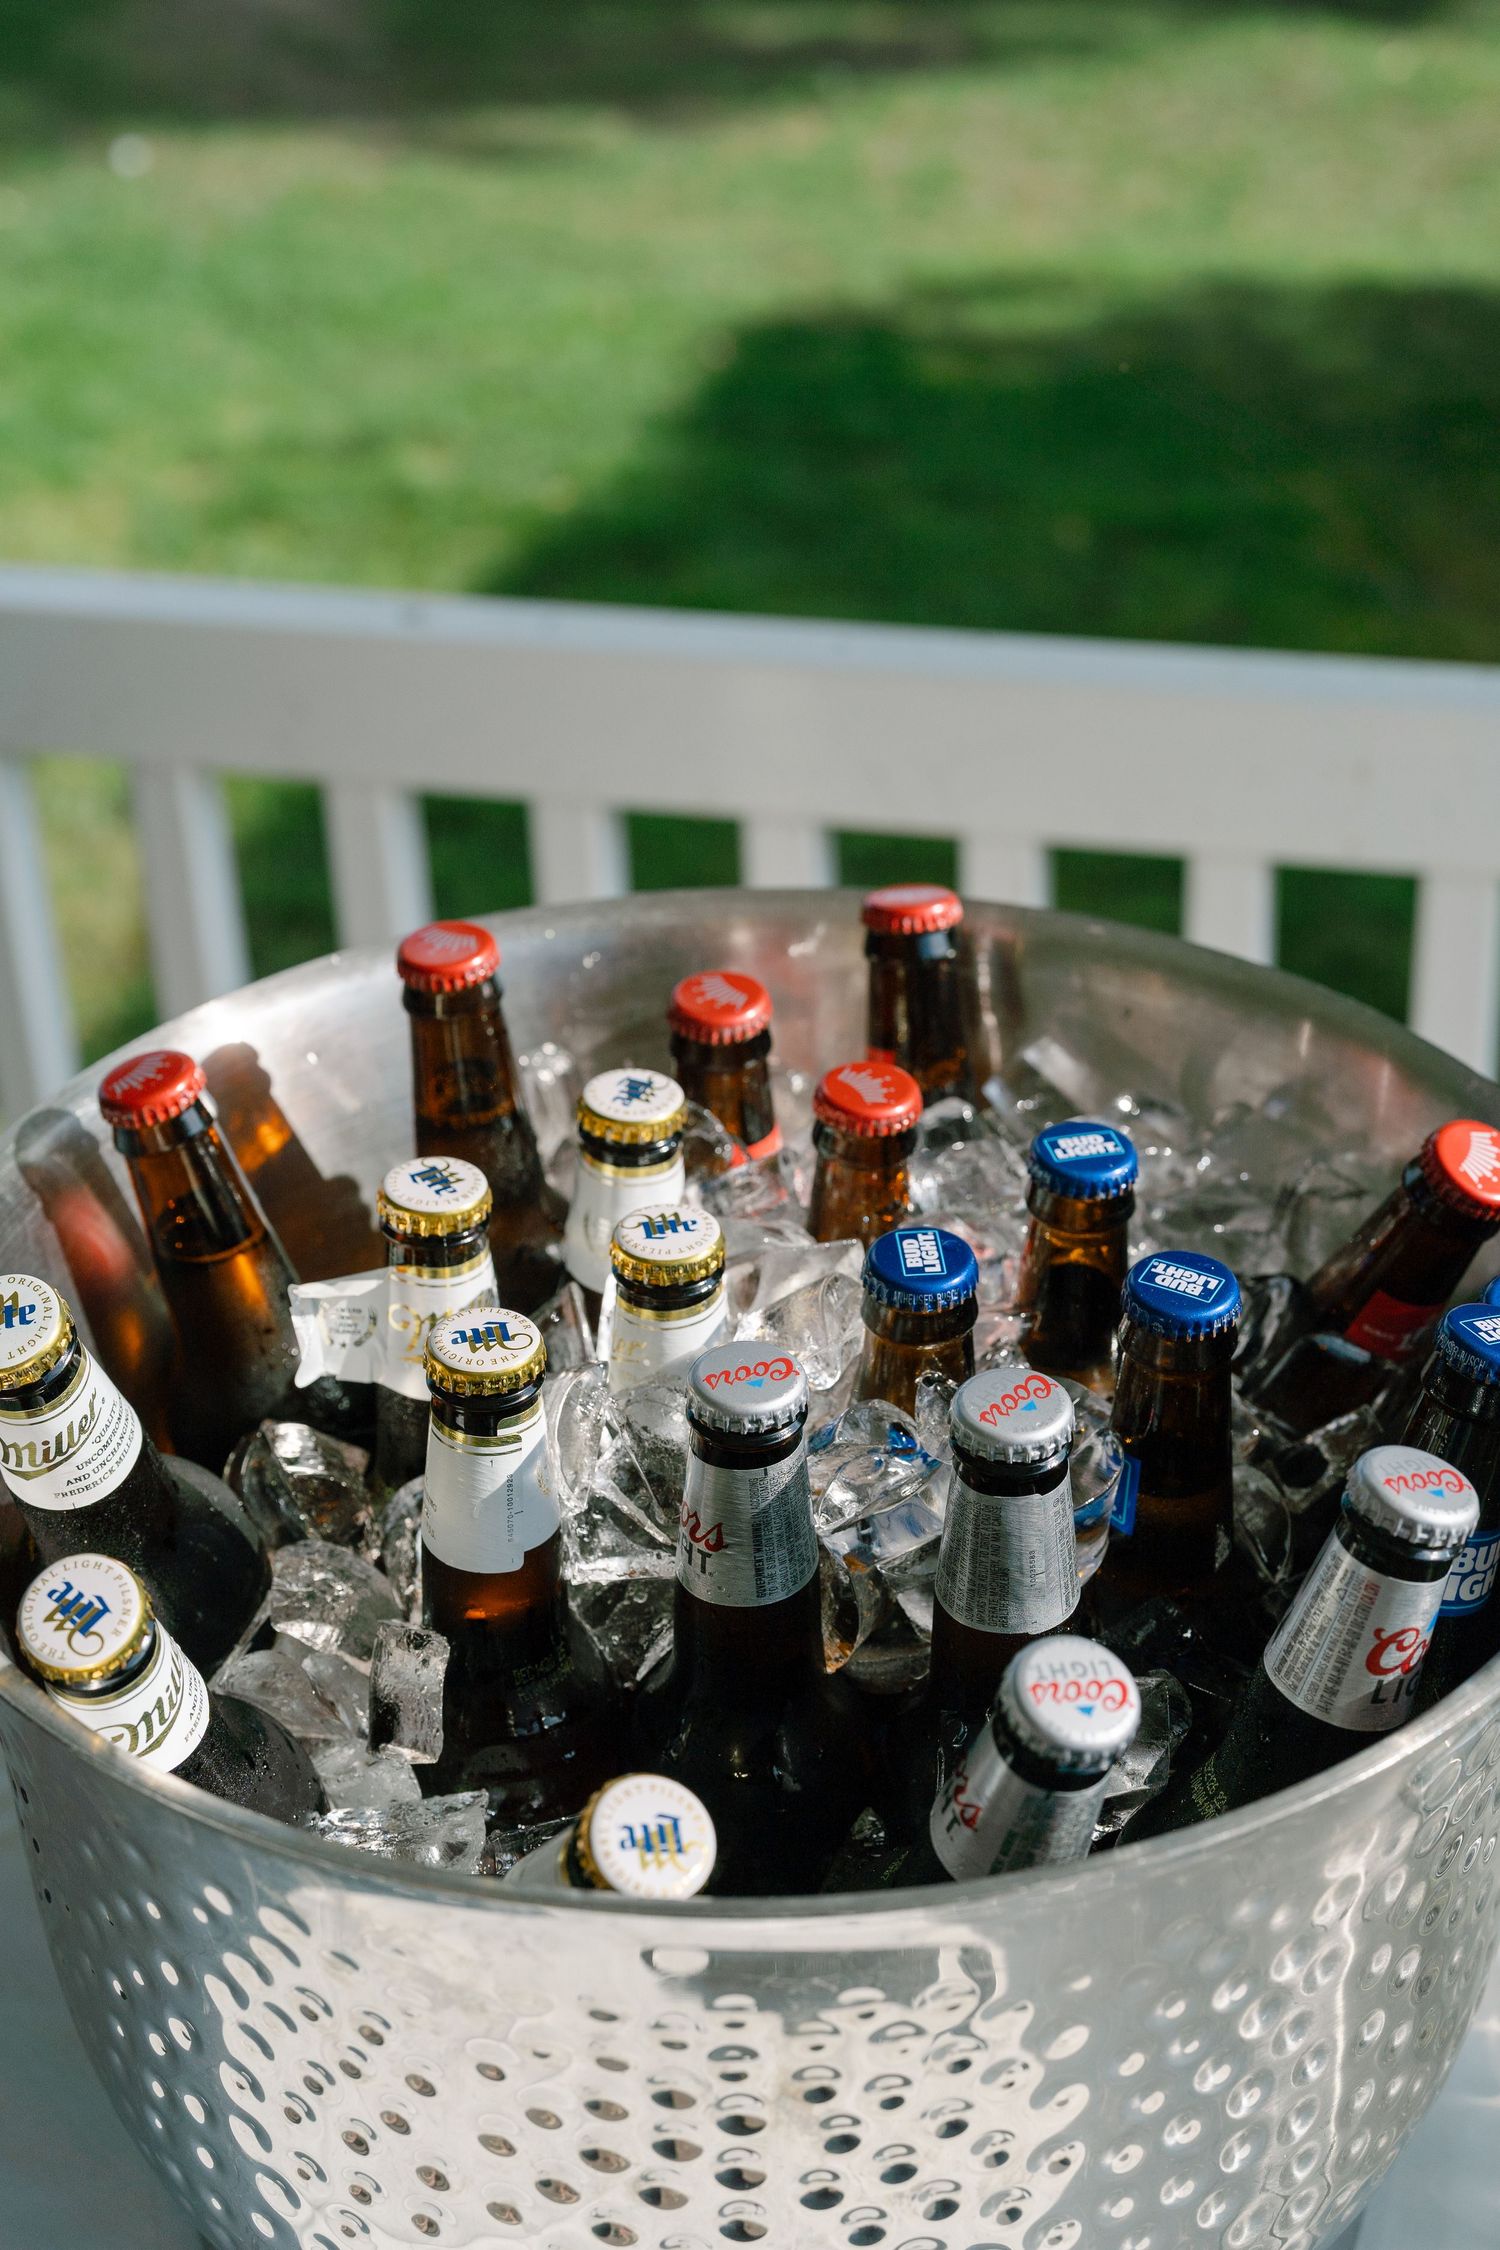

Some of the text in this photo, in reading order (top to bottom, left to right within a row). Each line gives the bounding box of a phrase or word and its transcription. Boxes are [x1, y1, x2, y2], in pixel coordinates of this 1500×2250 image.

[1057, 1134, 1105, 1149] BUD
[409, 1166, 457, 1197] Lite
[640, 1219, 698, 1240] Lite
[902, 1238, 923, 1268] BUD
[1154, 1274, 1204, 1296] BUD
[3, 1303, 37, 1329] te
[8, 1276, 53, 1361] ORIGINAL LIGHT
[448, 1320, 511, 1345] Lite
[479, 1307, 532, 1331] PILSNER
[1473, 1318, 1500, 1332] BU
[433, 1332, 486, 1367] ORIGINAL
[490, 1353, 519, 1367] THE
[702, 1357, 800, 1391] Coors
[979, 1374, 1059, 1427] Coors
[0, 1387, 97, 1469] Miller
[65, 1473, 91, 1487] AND
[1383, 1468, 1473, 1495] Coors
[679, 1501, 729, 1553] ors
[751, 1520, 763, 1553] WARNING:
[1451, 1538, 1500, 1574] BU
[753, 1555, 766, 1598] GOVERNMENT
[1442, 1563, 1498, 1601] IGH
[23, 1559, 133, 1661] THE ORIGINAL LIGHT PILSNER
[47, 1581, 112, 1638] Lite
[1035, 1660, 1113, 1681] LIGHT
[1030, 1679, 1135, 1713] Coors
[619, 1813, 684, 1854] Lite
